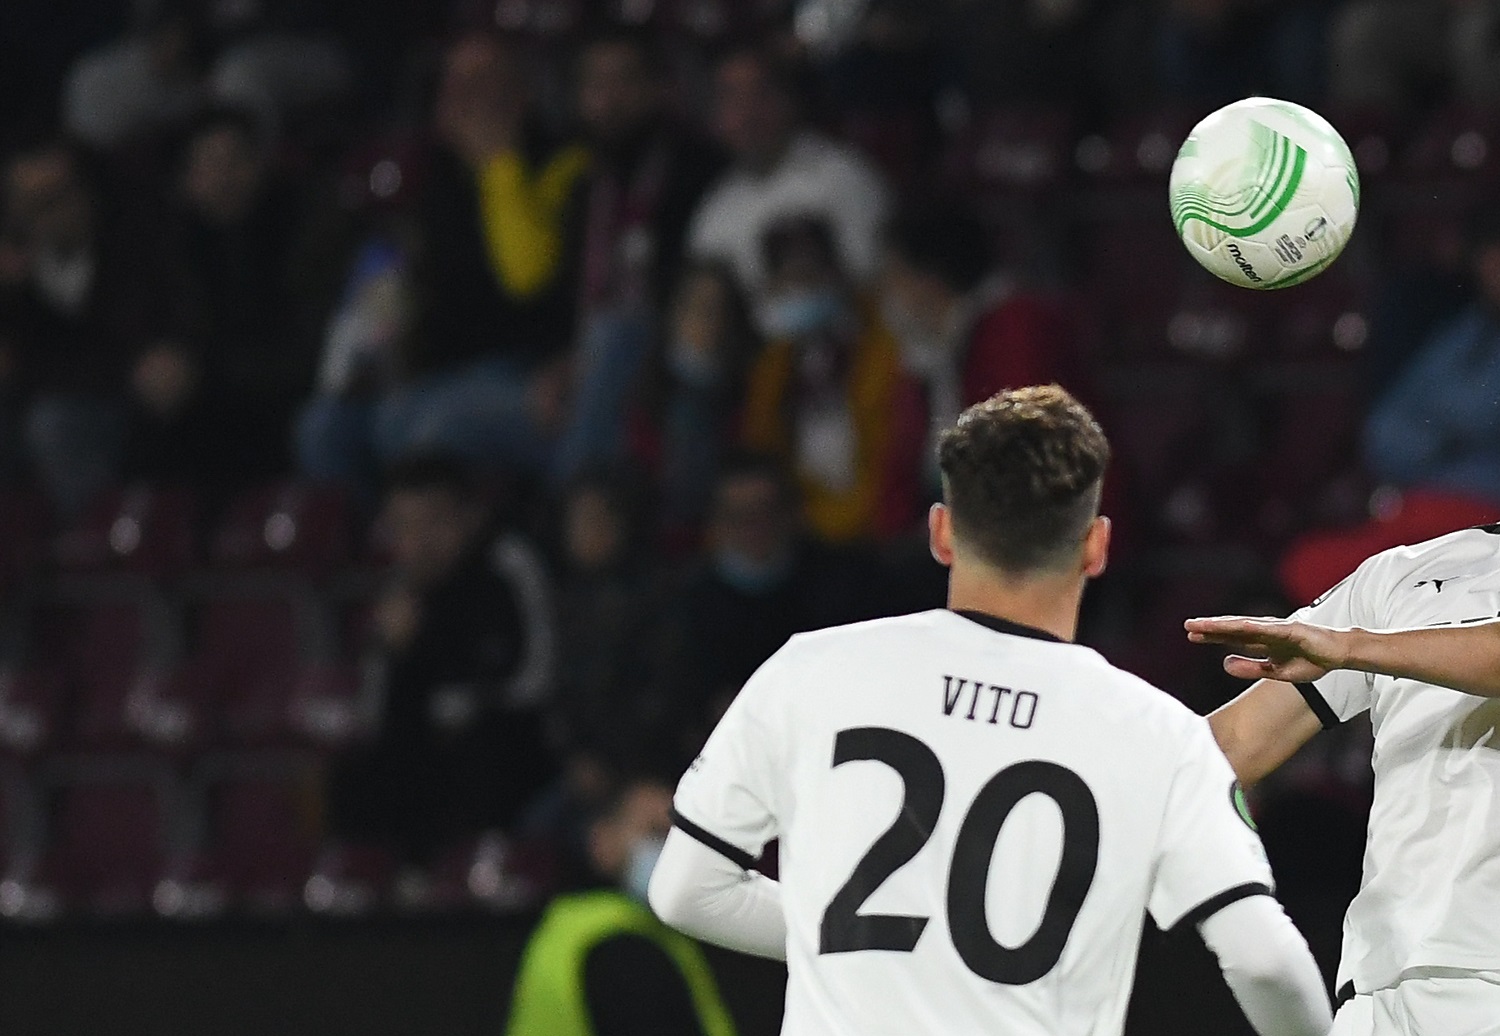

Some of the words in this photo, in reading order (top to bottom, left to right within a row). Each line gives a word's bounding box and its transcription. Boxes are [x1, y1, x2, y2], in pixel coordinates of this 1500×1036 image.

[1227, 243, 1262, 282] molten
[941, 674, 1041, 731] VITO
[818, 726, 1101, 985] 20
